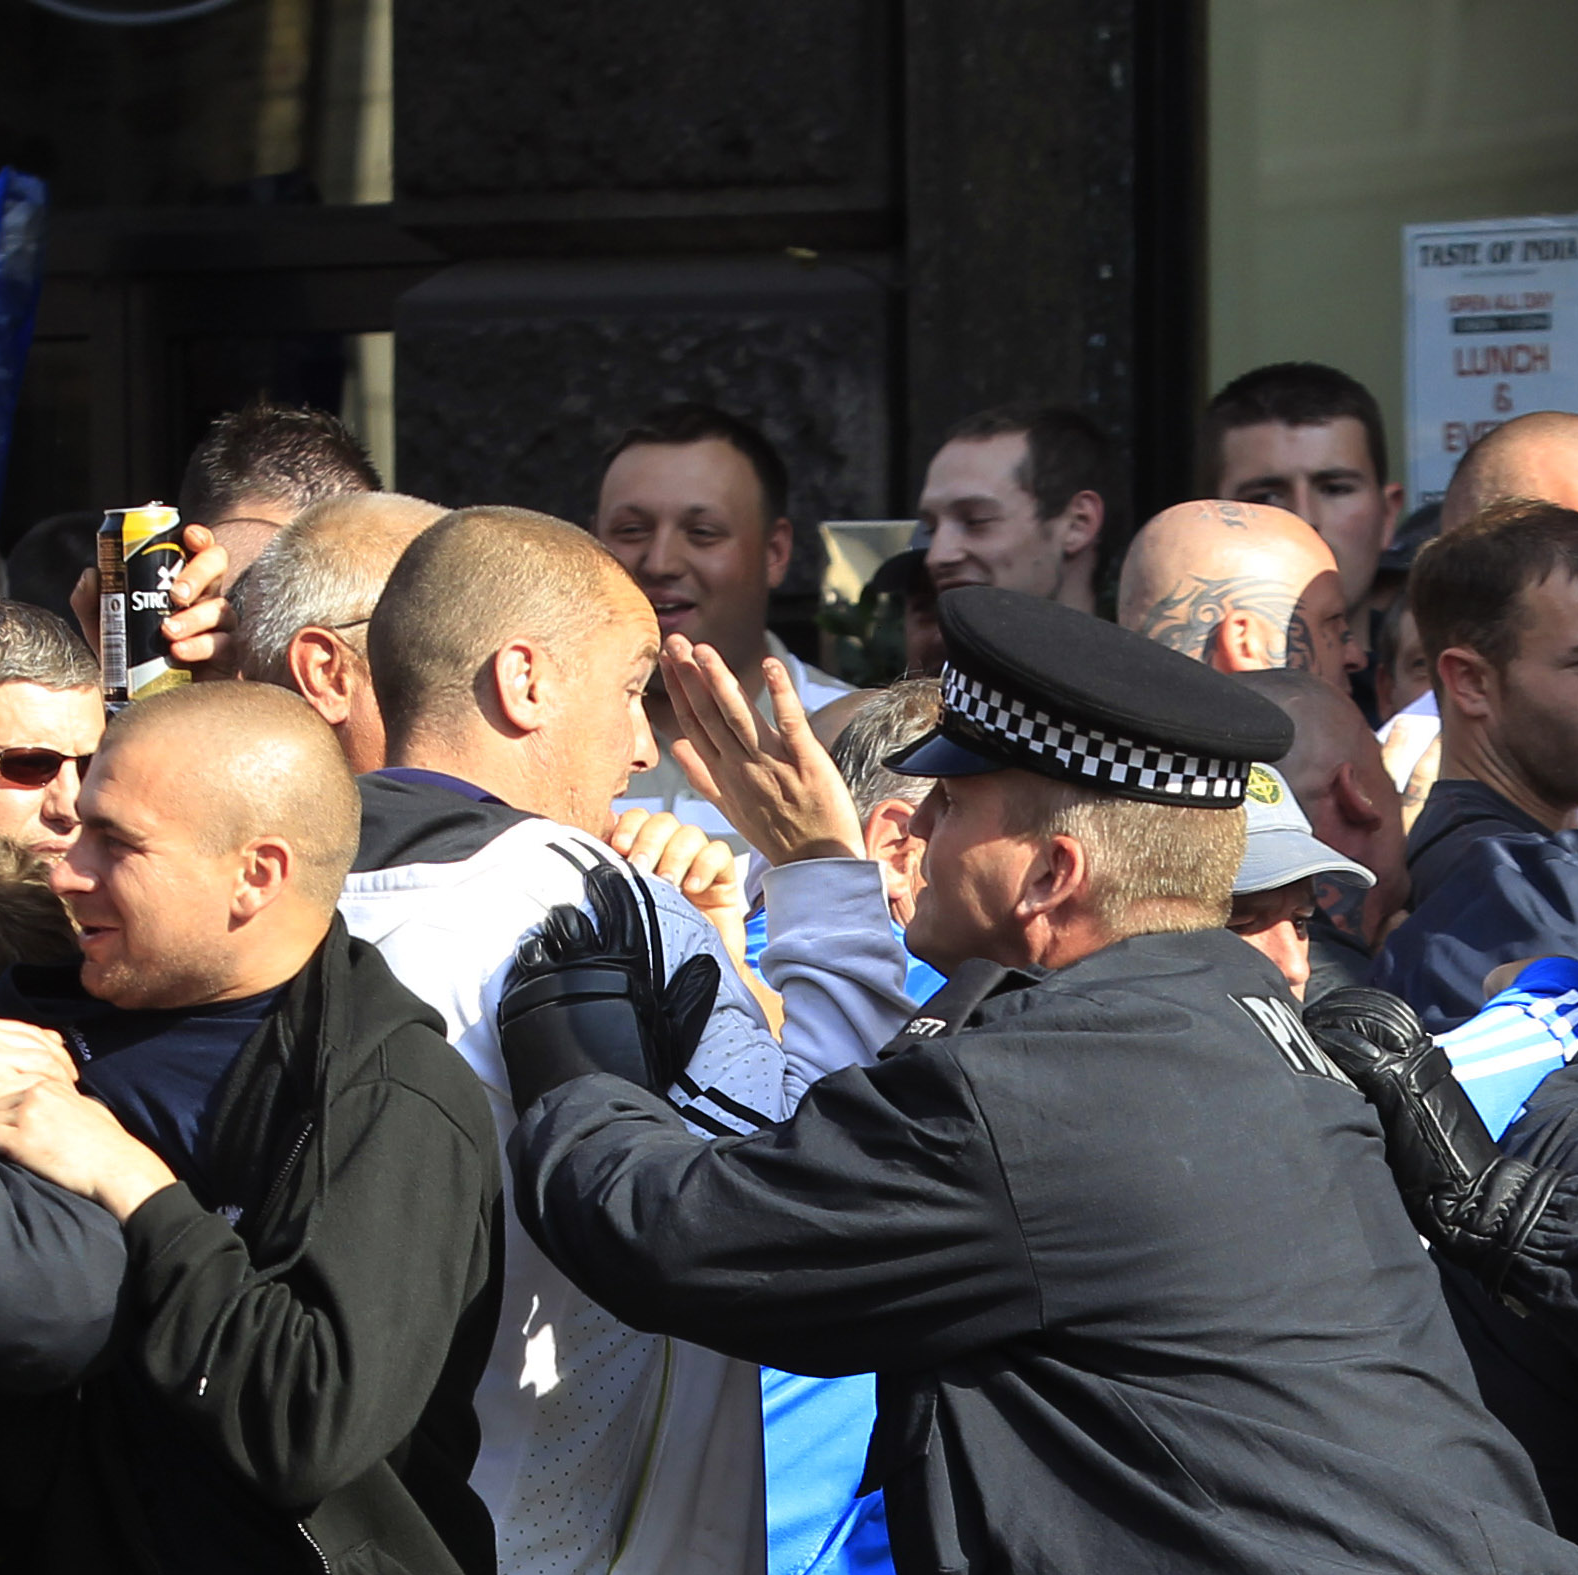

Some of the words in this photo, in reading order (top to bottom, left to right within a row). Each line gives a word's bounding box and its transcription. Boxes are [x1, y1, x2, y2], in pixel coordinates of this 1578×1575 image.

[1419, 242, 1481, 267] TASTE
[1488, 240, 1515, 264] OF
[1519, 237, 1578, 262] INDIA
[1454, 343, 1549, 377] LUNCH
